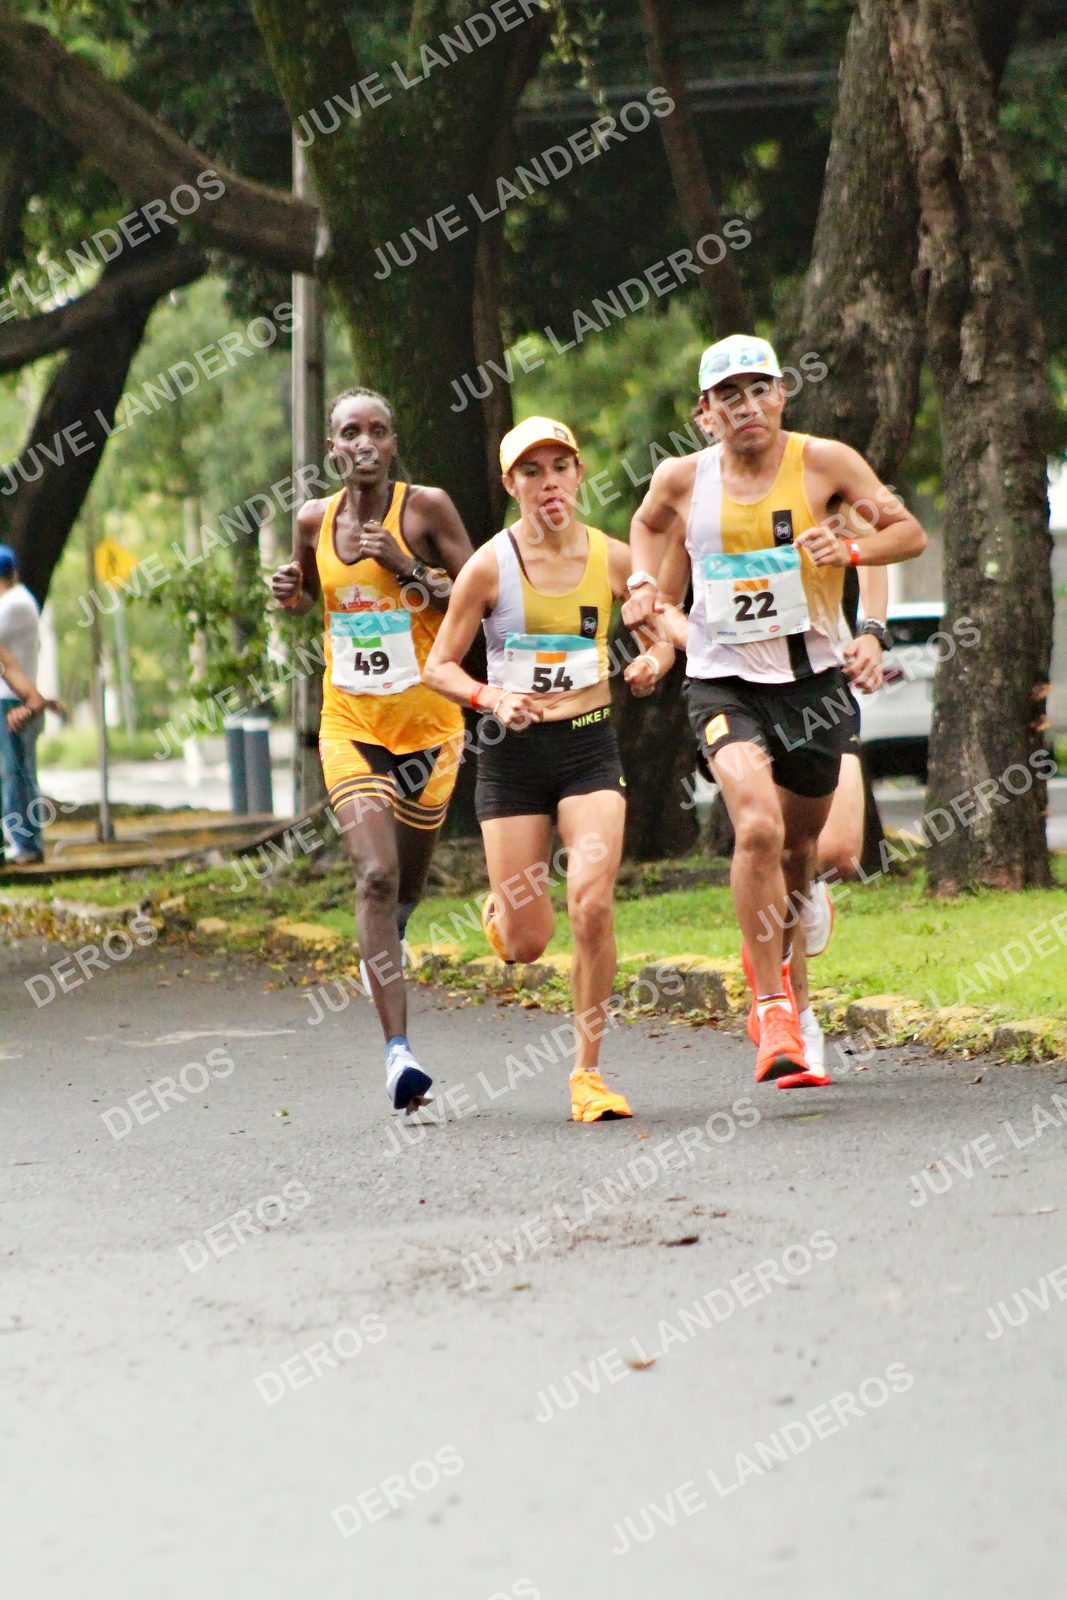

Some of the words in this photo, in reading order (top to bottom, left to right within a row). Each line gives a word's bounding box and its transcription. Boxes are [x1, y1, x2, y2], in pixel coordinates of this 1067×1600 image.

[732, 591, 777, 622] 22
[354, 650, 390, 675] 49
[531, 666, 573, 693] 54
[572, 709, 602, 730] NIKE
